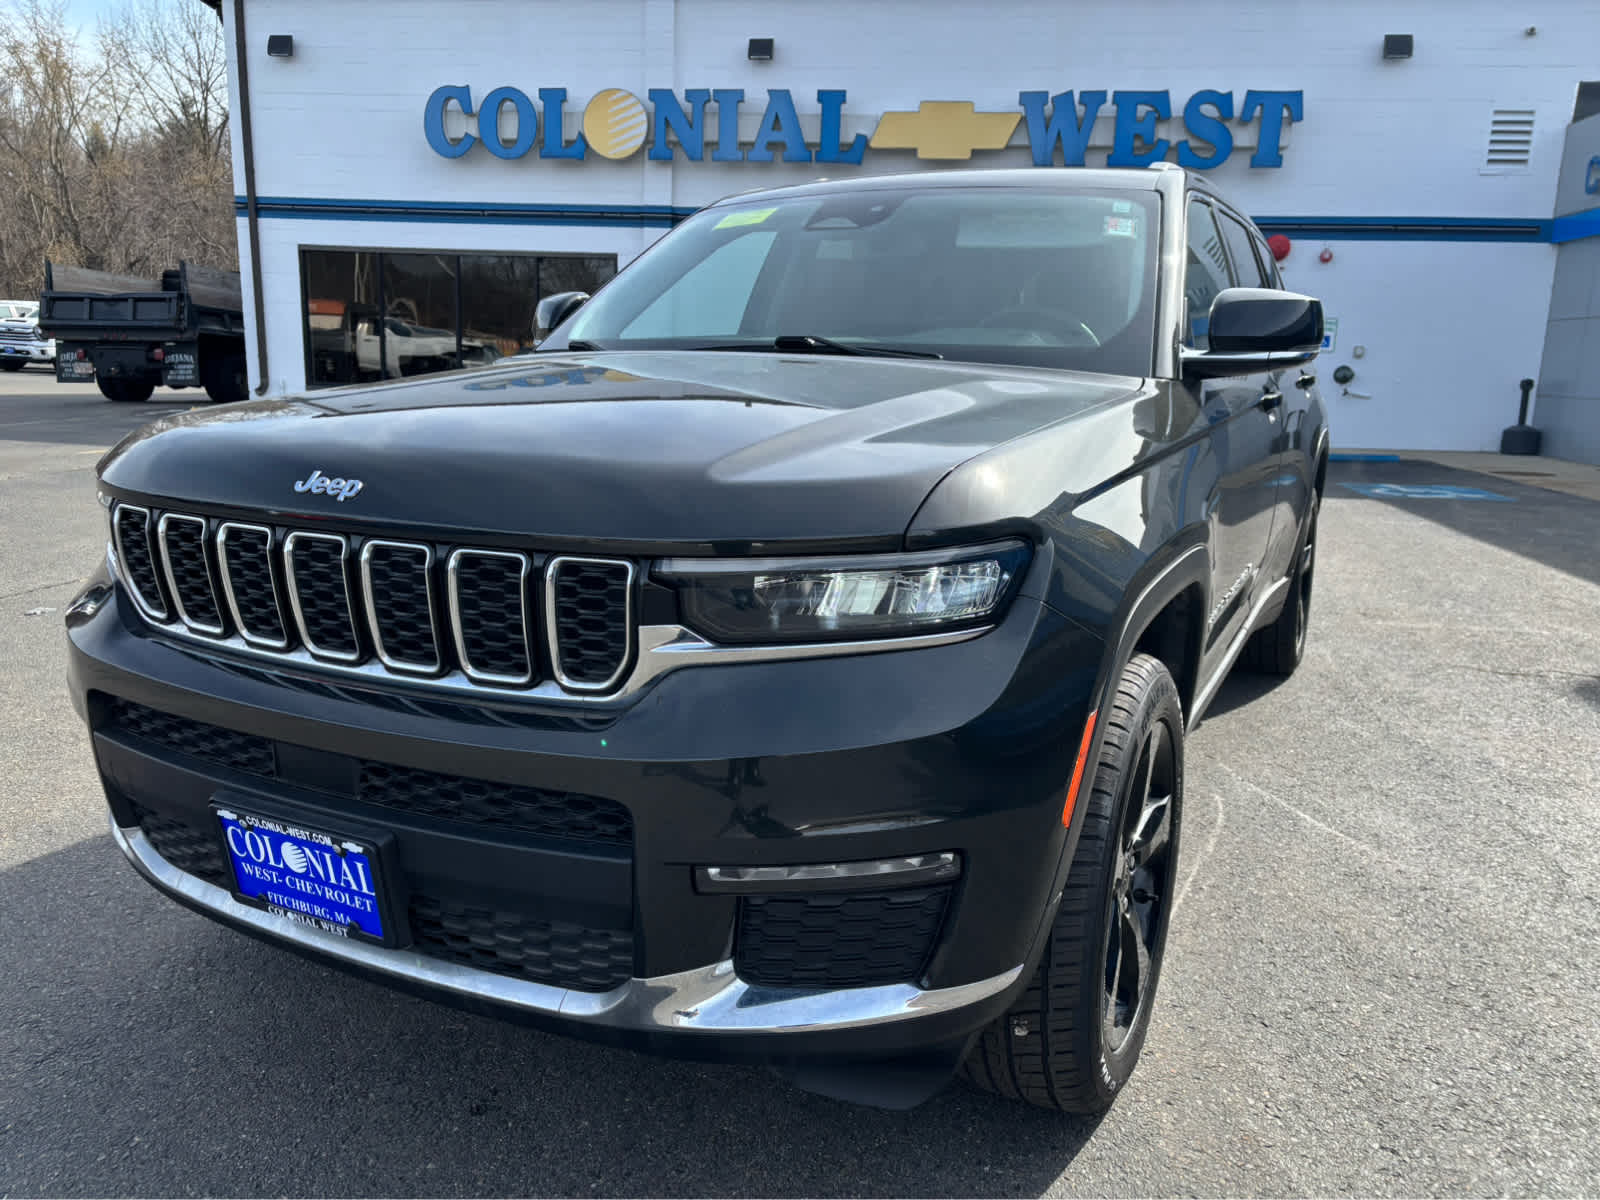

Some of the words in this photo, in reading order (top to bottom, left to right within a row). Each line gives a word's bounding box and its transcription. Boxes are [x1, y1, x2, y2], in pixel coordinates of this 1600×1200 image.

[423, 84, 868, 166] COLONIAL
[1018, 88, 1304, 169] WEST
[294, 470, 363, 502] Jeep
[226, 825, 376, 896] COLONIAL
[285, 875, 374, 913] CHEVROLET
[320, 921, 349, 938] WEST
[334, 913, 351, 926] MA
